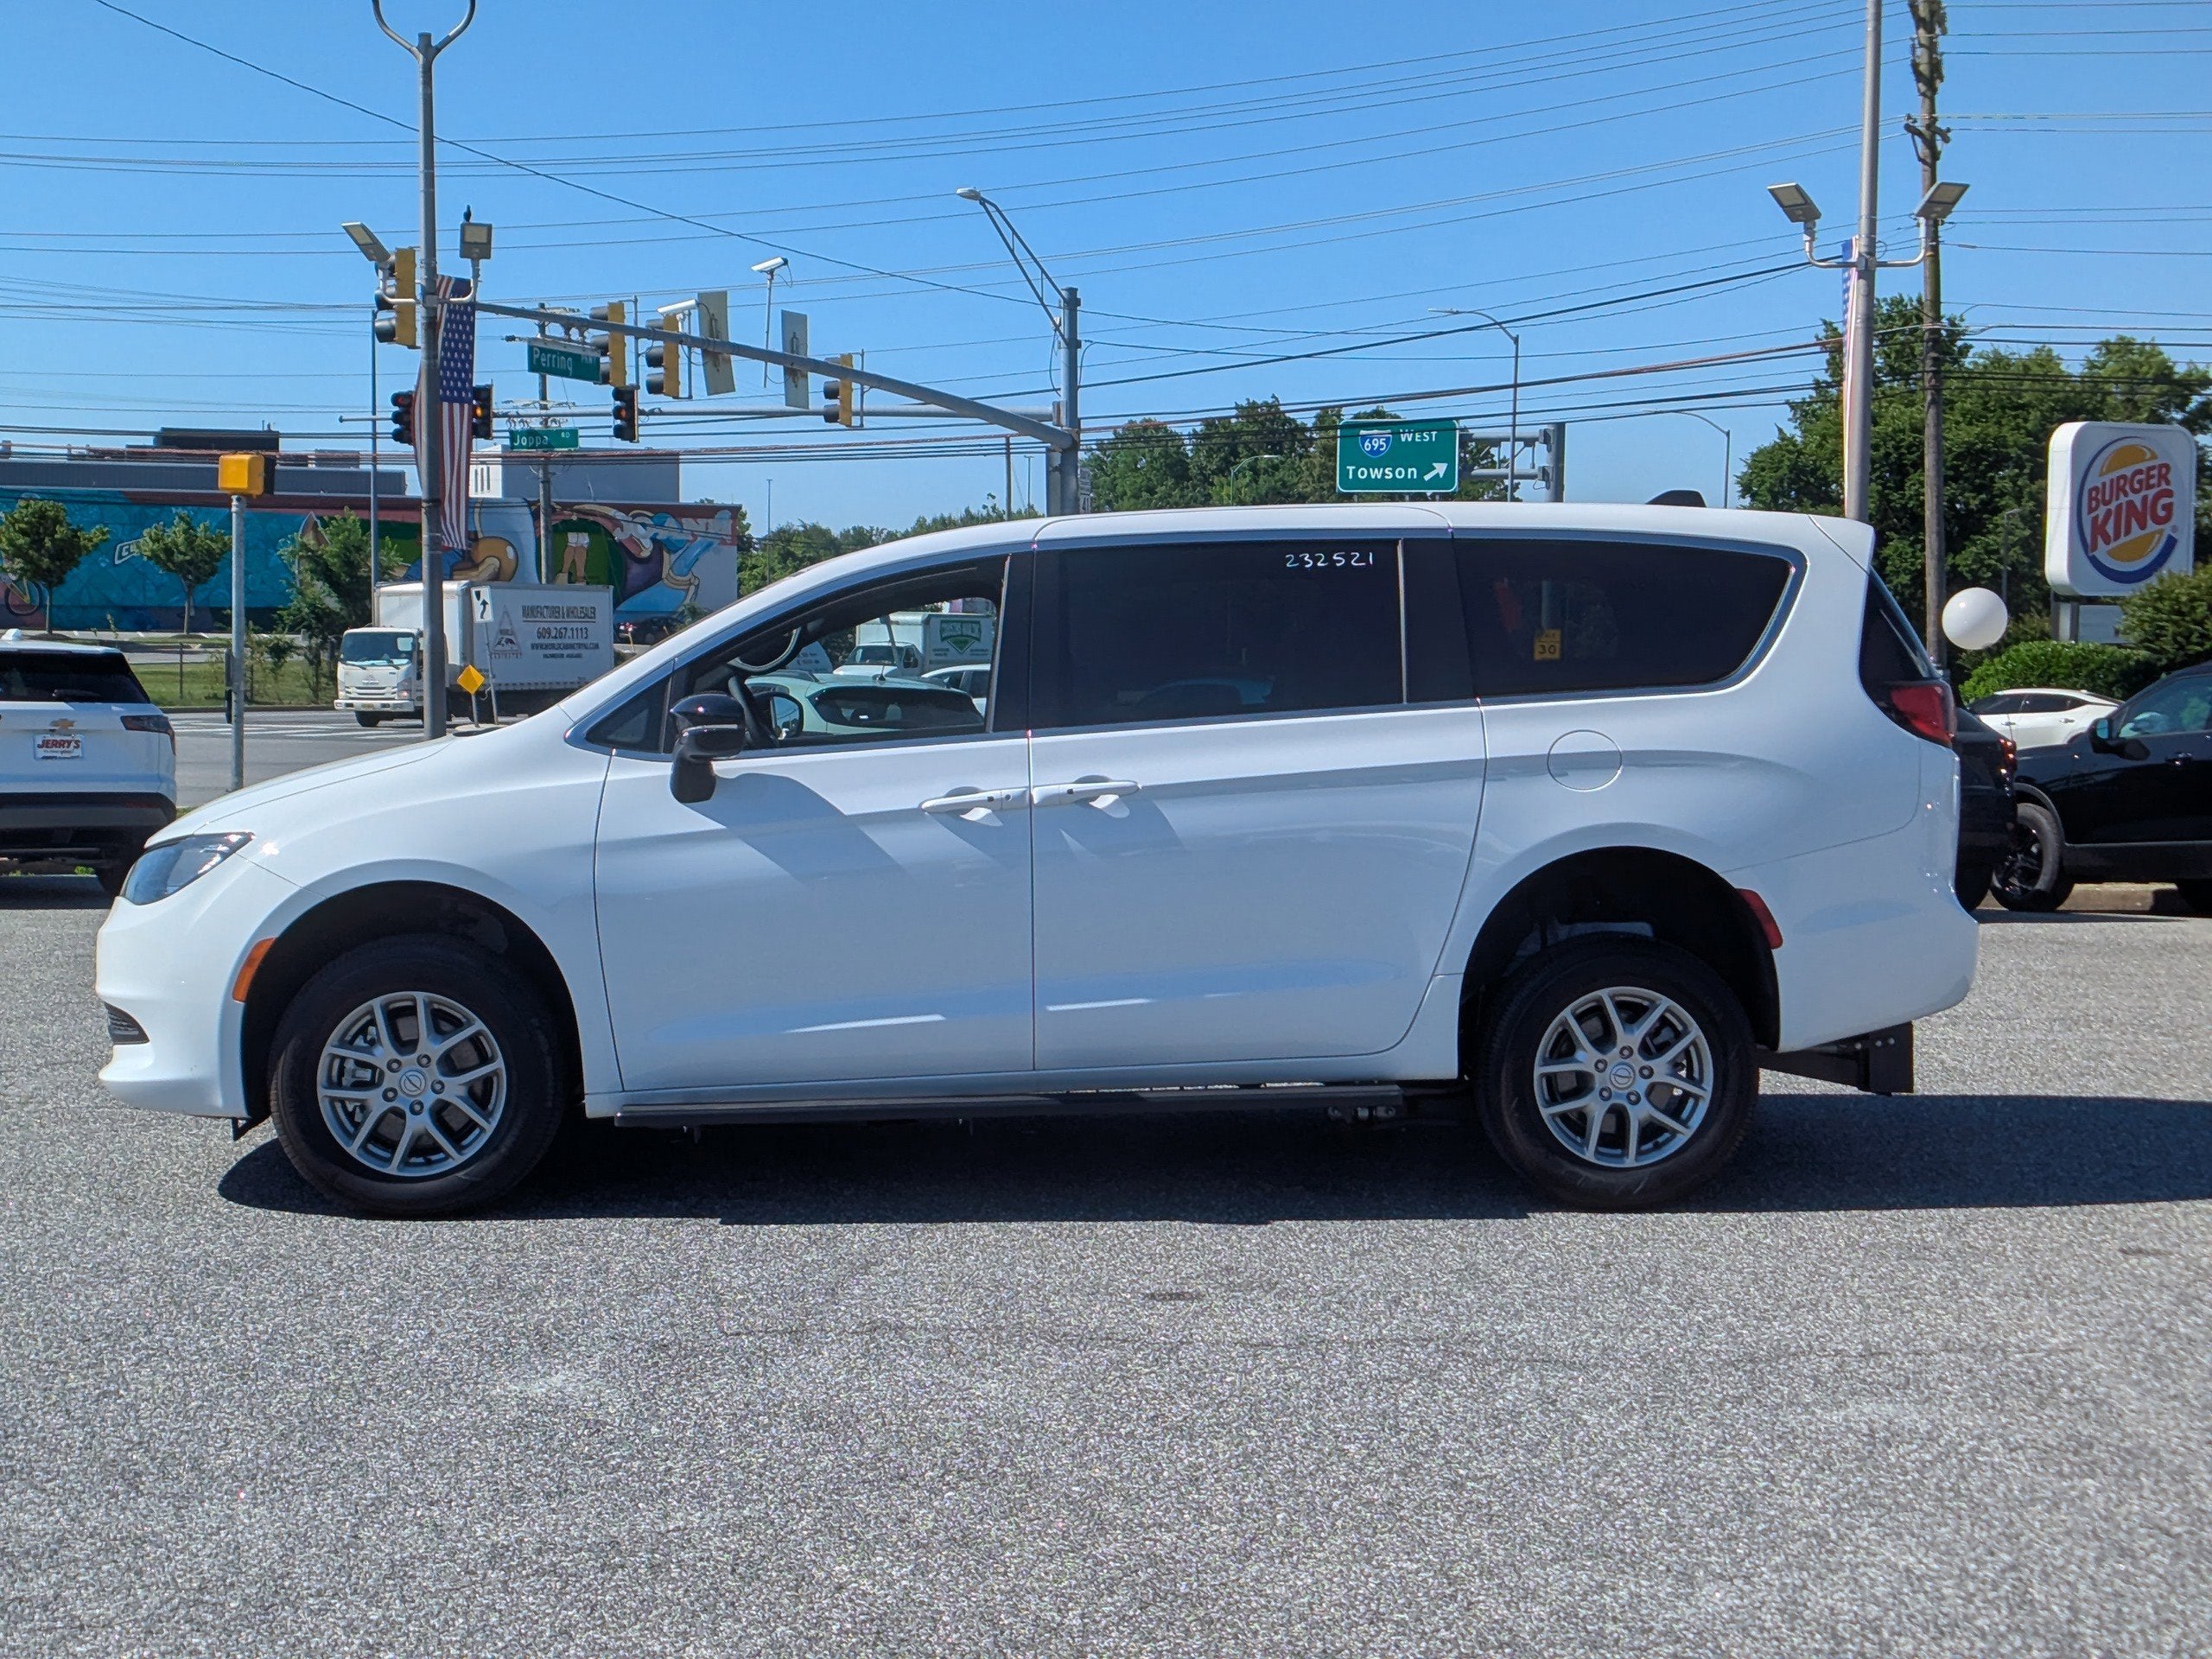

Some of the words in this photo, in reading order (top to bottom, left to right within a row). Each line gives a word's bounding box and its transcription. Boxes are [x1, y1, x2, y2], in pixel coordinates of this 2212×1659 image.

[532, 346, 573, 377] Perring
[513, 434, 549, 447] Joppa
[1364, 438, 1387, 451] 695
[1400, 429, 1438, 442] WEST
[2087, 462, 2171, 515] BURGER
[2089, 488, 2175, 553] KING
[1285, 552, 1373, 568] 232521
[537, 626, 589, 639] 609.267.1113
[37, 739, 82, 749] JERRY'S
